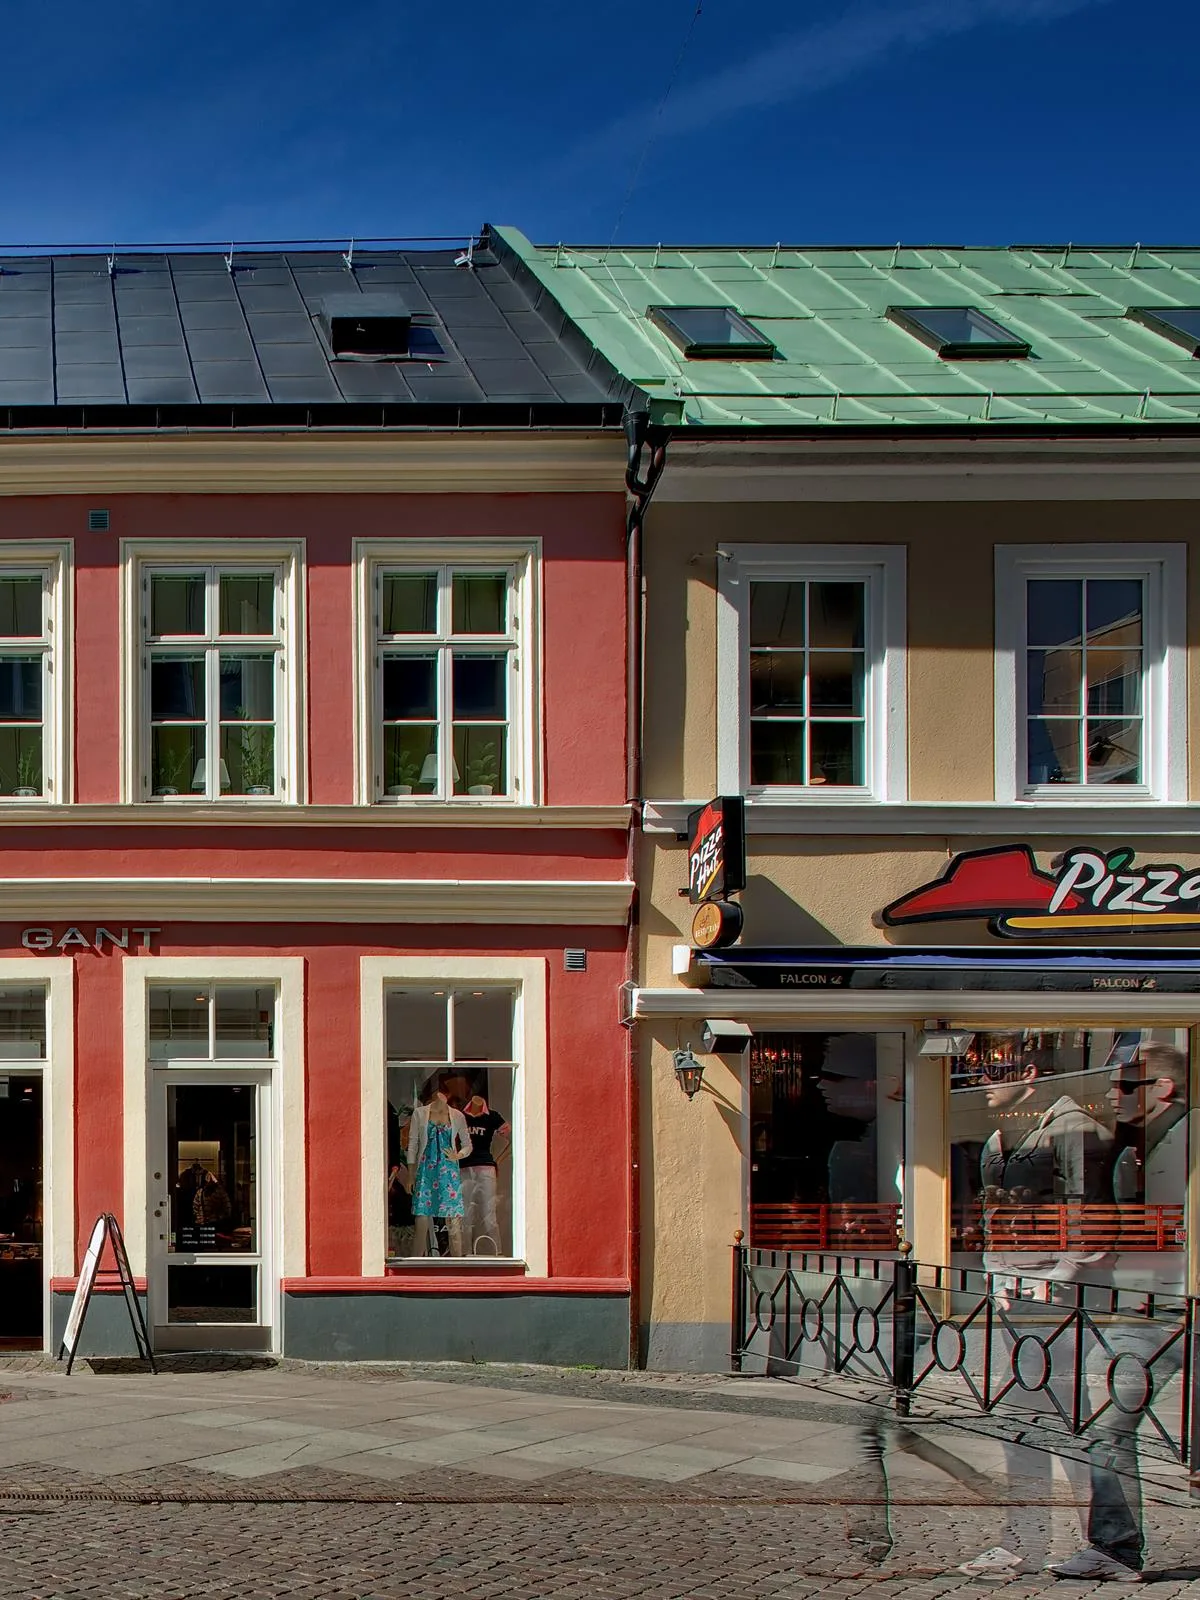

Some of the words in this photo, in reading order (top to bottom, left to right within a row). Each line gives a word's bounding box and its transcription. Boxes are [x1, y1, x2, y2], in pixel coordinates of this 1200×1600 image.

[690, 825, 722, 890] Pizza
[696, 847, 722, 894] Hut
[21, 927, 162, 948] GANT
[780, 974, 827, 984] FALCON
[1093, 978, 1139, 988] FALCON
